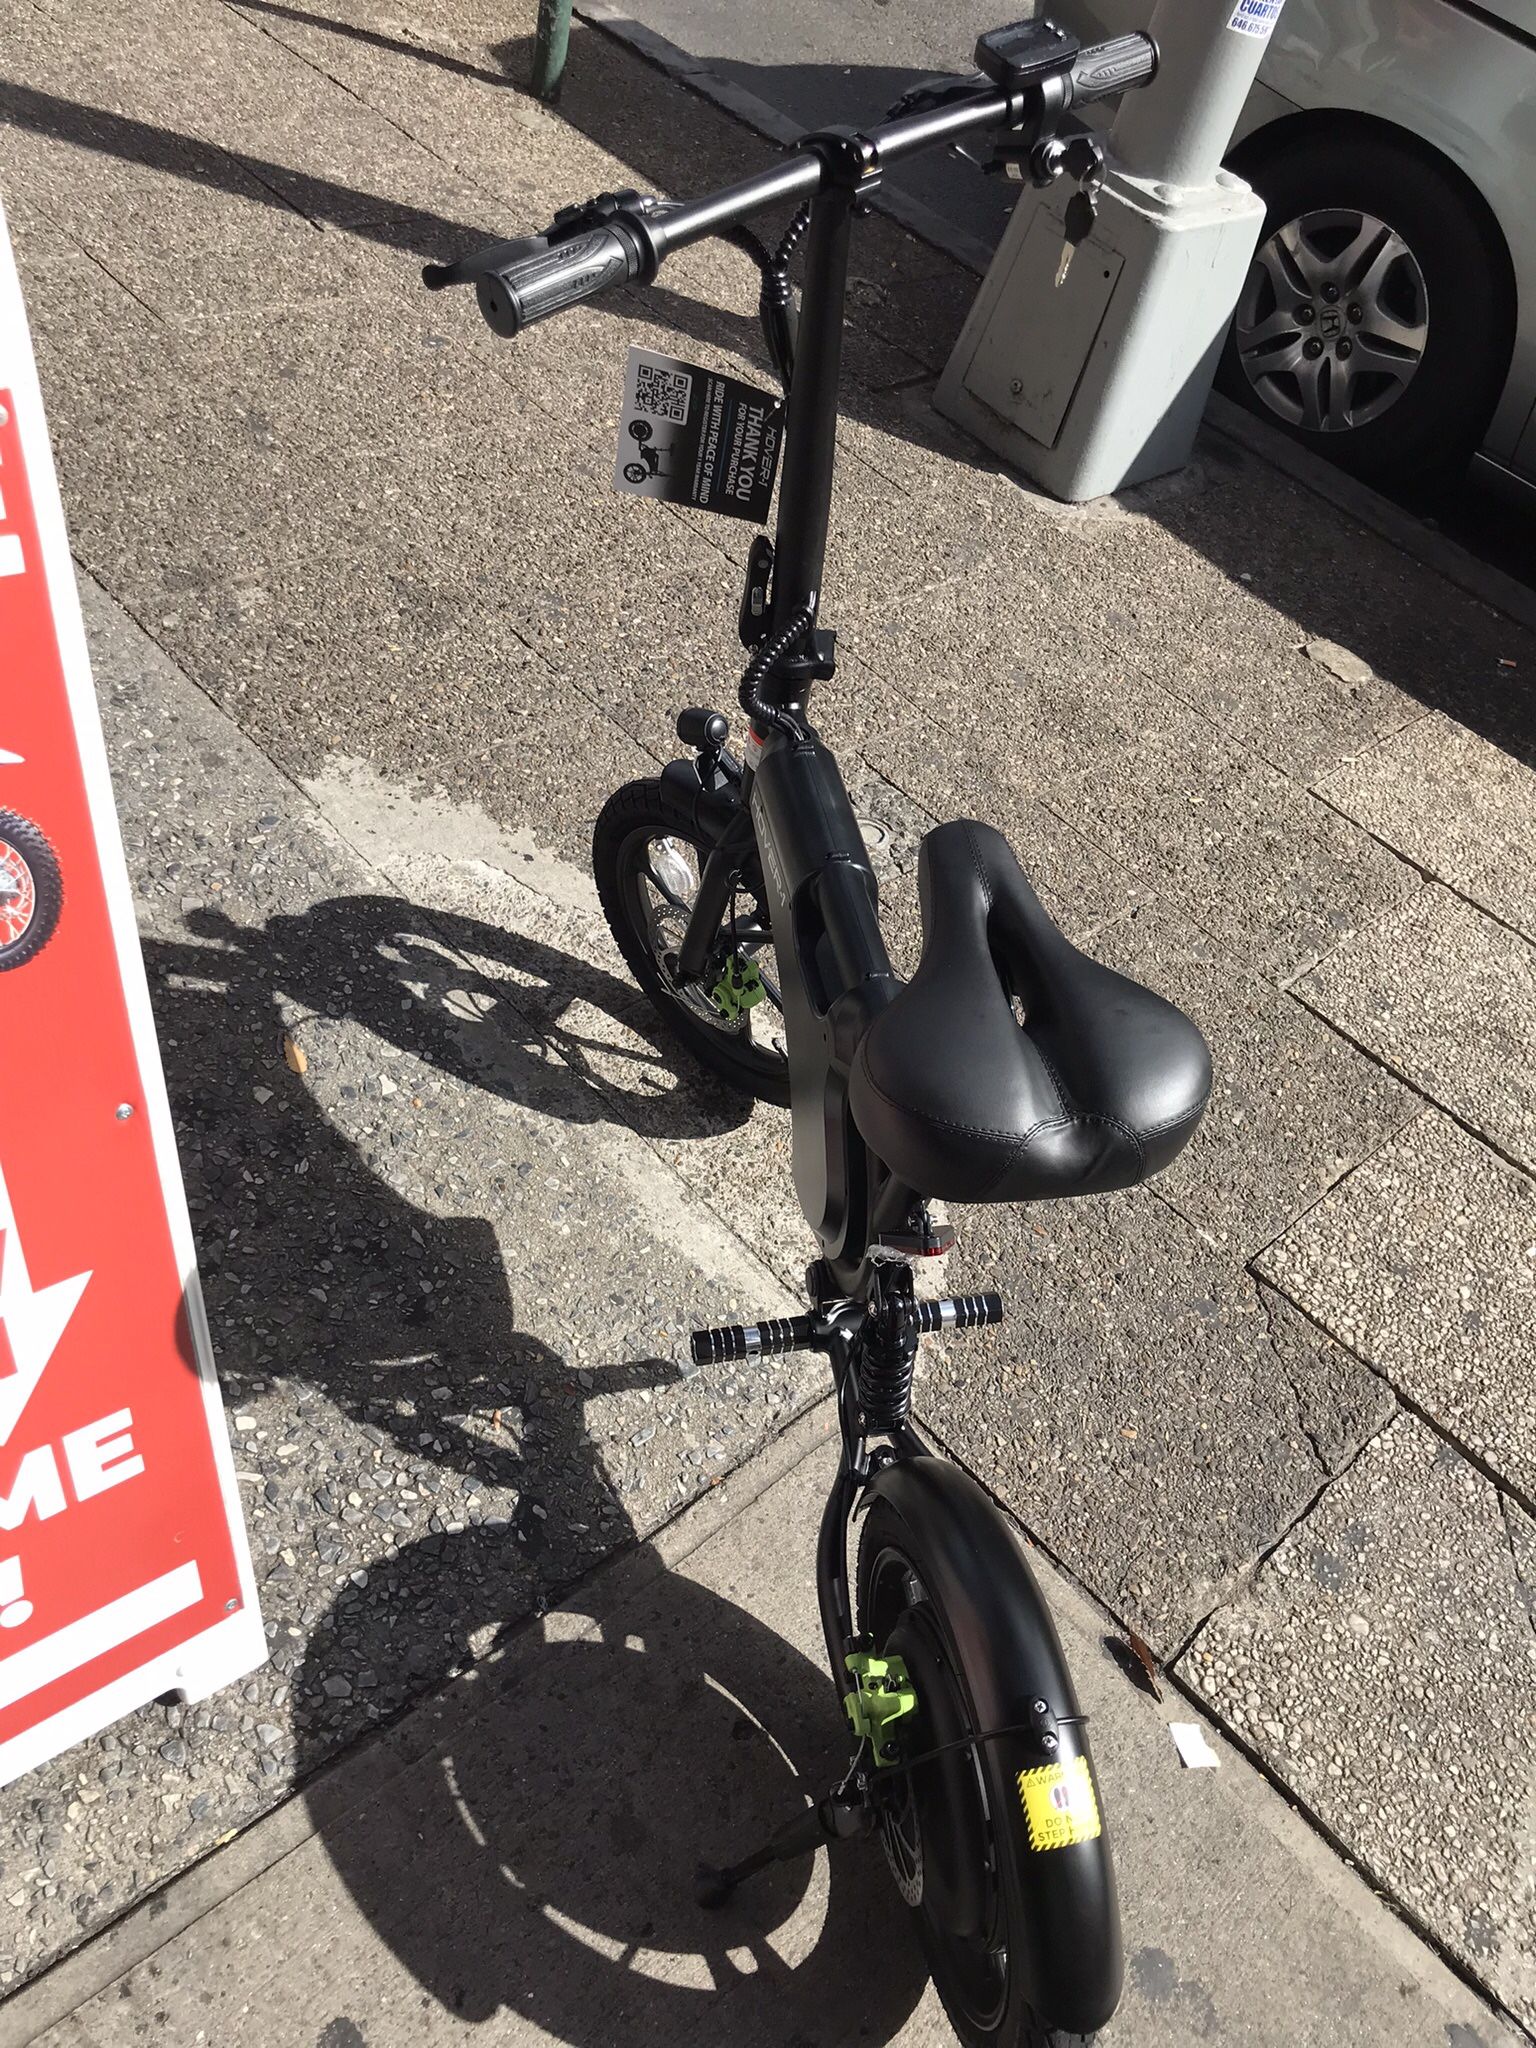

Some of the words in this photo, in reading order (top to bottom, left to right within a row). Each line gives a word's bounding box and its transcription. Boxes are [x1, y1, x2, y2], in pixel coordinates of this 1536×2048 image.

[714, 381, 725, 404] RIDE
[711, 405, 722, 430] WITH
[738, 403, 747, 421] FOR
[706, 431, 718, 462] PEACE
[734, 422, 744, 446] YOUR
[742, 407, 764, 463] THANK
[759, 426, 777, 487] HOVER-1
[704, 463, 713, 477] OF
[725, 448, 740, 495] PURCHASE
[700, 477, 712, 503] MIND
[736, 467, 755, 501] YOU
[1038, 1828, 1066, 1842] STEP
